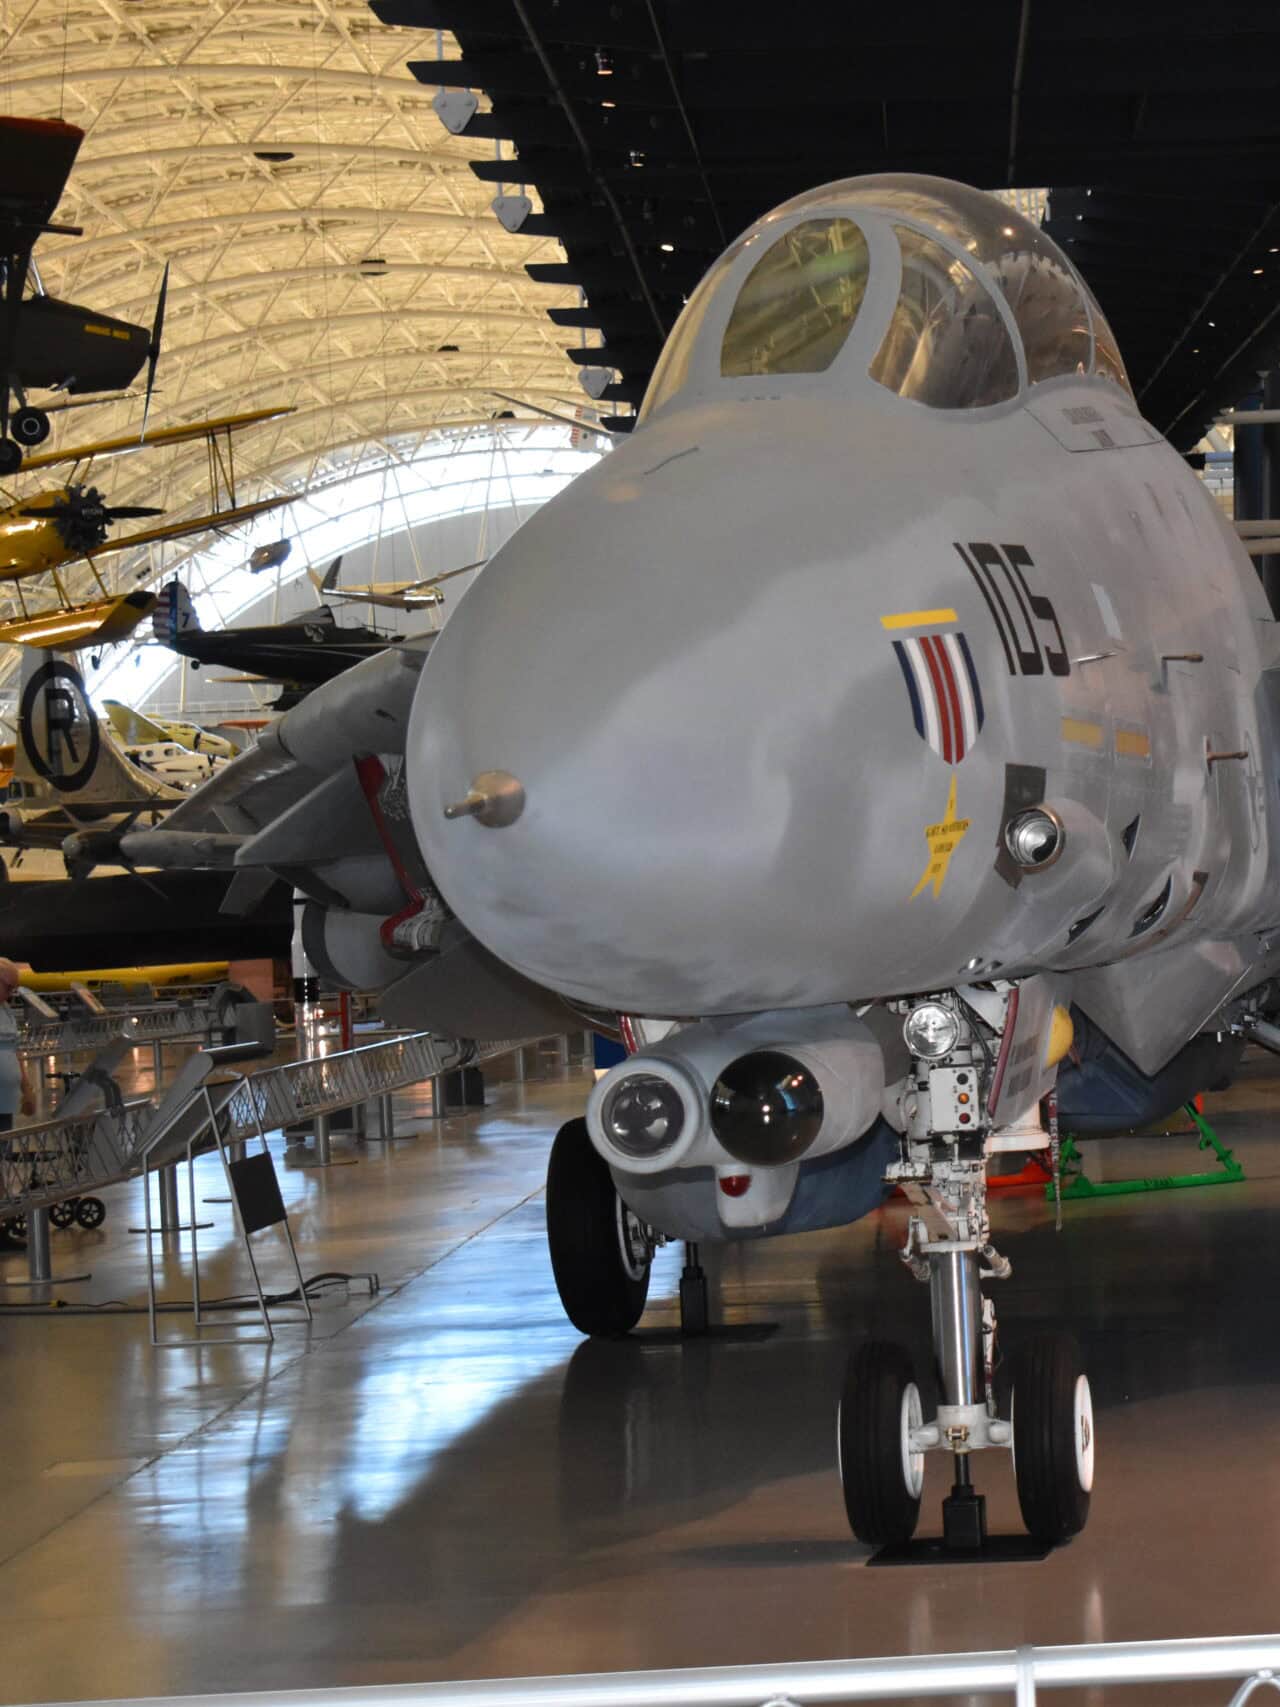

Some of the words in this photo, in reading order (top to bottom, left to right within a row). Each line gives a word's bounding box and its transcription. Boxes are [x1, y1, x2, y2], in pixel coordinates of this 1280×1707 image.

[182, 612, 192, 628] 7
[952, 542, 1071, 677] 105
[45, 687, 80, 764] R
